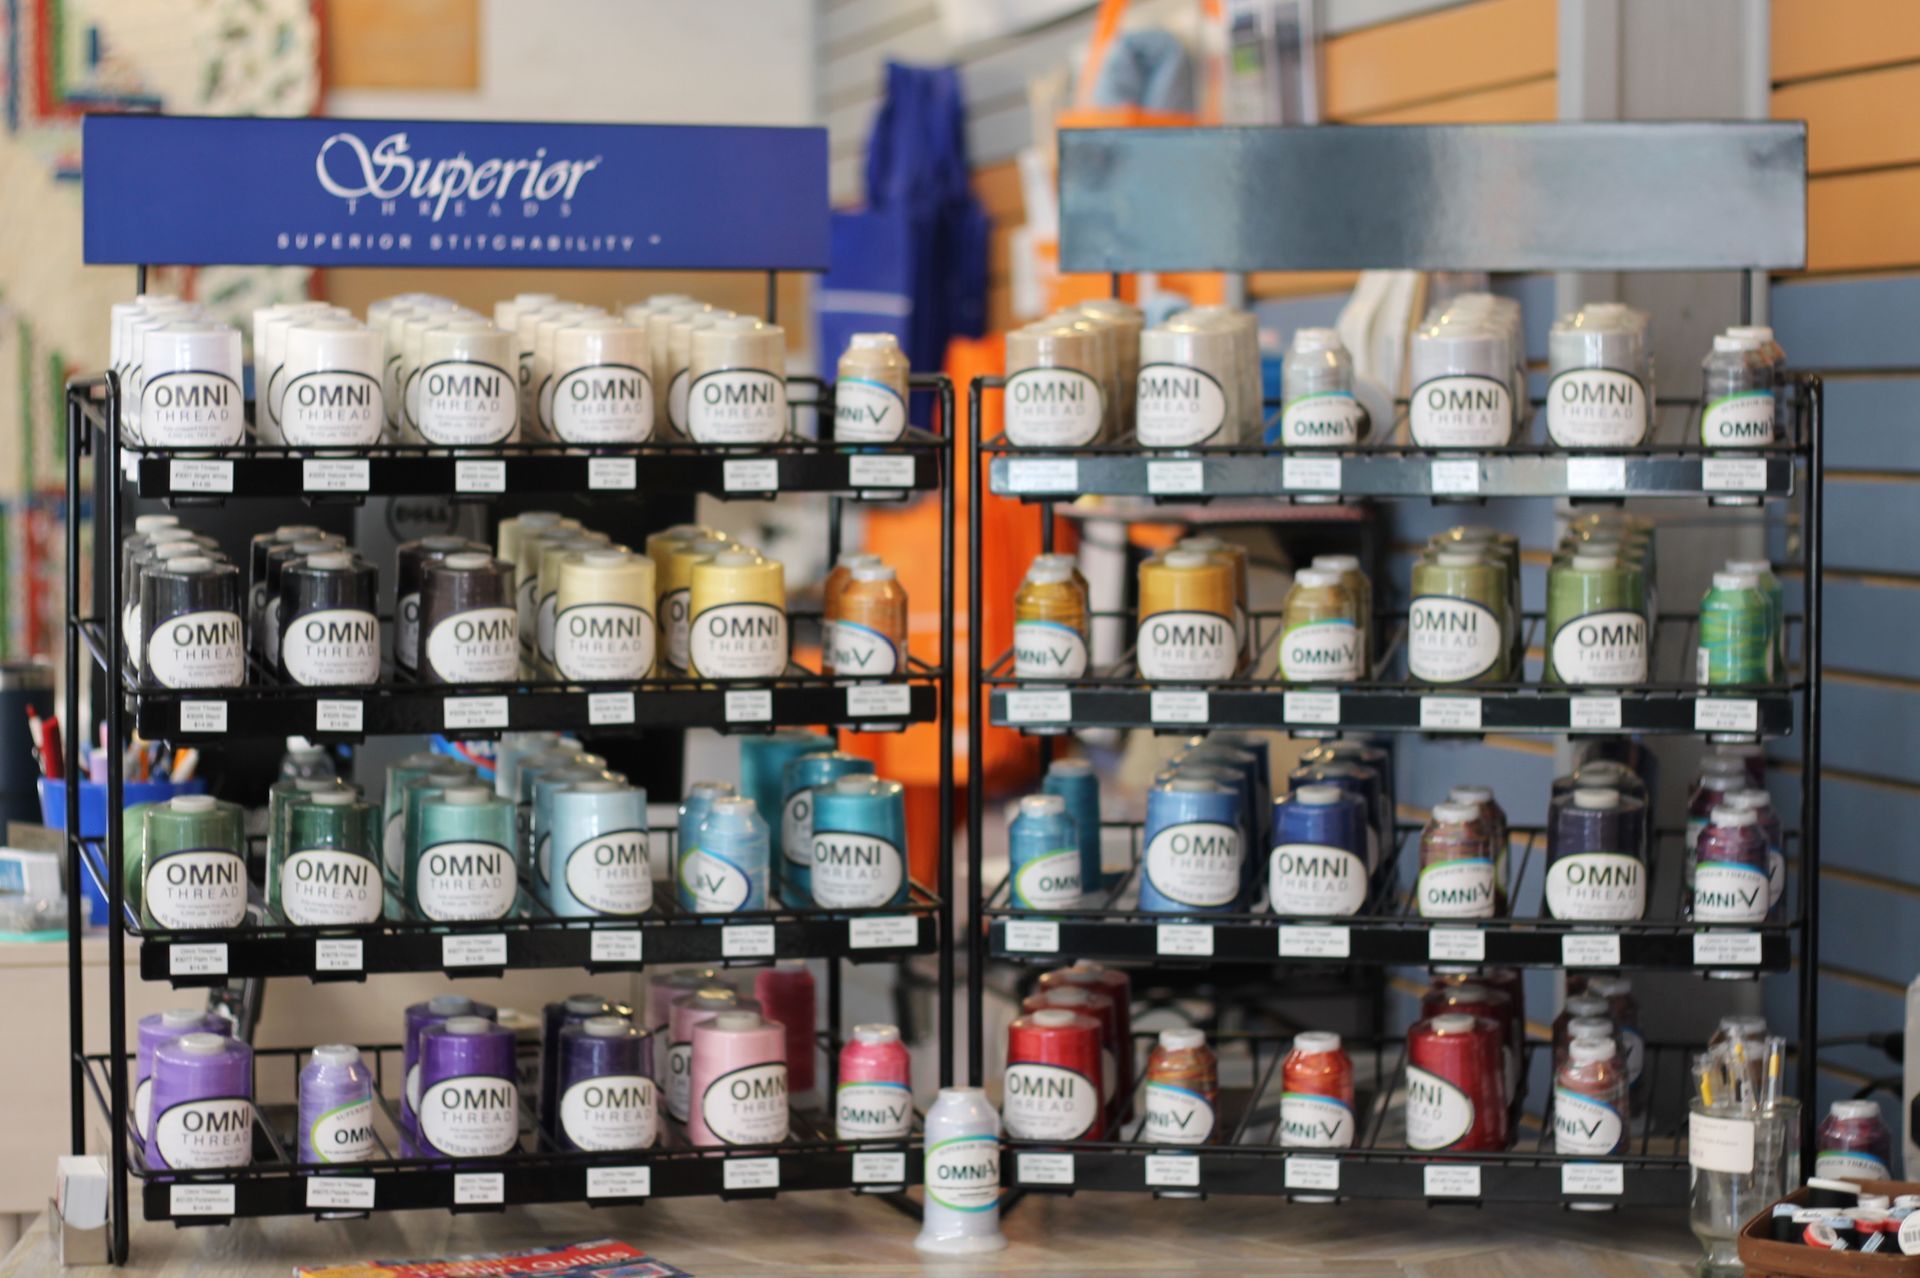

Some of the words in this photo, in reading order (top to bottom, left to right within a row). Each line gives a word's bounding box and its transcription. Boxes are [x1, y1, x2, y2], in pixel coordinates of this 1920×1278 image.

[316, 132, 600, 222] Superior
[347, 200, 573, 218] THREADS
[277, 232, 412, 250] SUPERIOR
[430, 233, 634, 251] STITCHABILITY
[155, 385, 228, 407] OMNI
[298, 384, 370, 407] OMNI
[429, 374, 500, 398] OMNI
[571, 378, 643, 401] OMNI
[703, 382, 774, 405] OMNI
[1014, 381, 1084, 403] OMNI
[1561, 380, 1633, 405] OMNI
[429, 400, 500, 413] THREAD
[571, 403, 643, 416] THREAD
[1428, 388, 1499, 411] OMNI
[155, 409, 230, 423] THREAD
[297, 409, 371, 422] THREAD
[703, 406, 776, 418] THREAD
[835, 405, 889, 425] MNI-V
[173, 623, 241, 646] OMNI
[305, 621, 375, 643] OMNI
[569, 615, 641, 638] OMNI
[708, 615, 778, 639] OMNI
[1152, 624, 1223, 646] OMNI
[1578, 624, 1645, 647] OMNI
[174, 648, 241, 662] THREAD
[305, 645, 375, 658] THREAD
[569, 640, 642, 653] THREAD
[709, 640, 778, 652] THREAD
[1170, 833, 1238, 856] OMNI
[166, 862, 238, 885] OMNI
[295, 859, 368, 885] OMNI
[430, 854, 501, 877] OMNI
[1278, 853, 1348, 877] OMNI
[1566, 862, 1637, 886] OMNI
[166, 886, 239, 900] THREAD
[294, 883, 368, 901] THREAD
[429, 878, 502, 891] THREAD
[1008, 1071, 1074, 1098] OMNI
[441, 1087, 511, 1110] OMNI
[583, 1086, 652, 1108] OMNI
[182, 1108, 249, 1132] OMNI
[441, 1111, 512, 1124] THREAD
[583, 1109, 652, 1122] THREAD
[182, 1133, 250, 1147] THREAD
